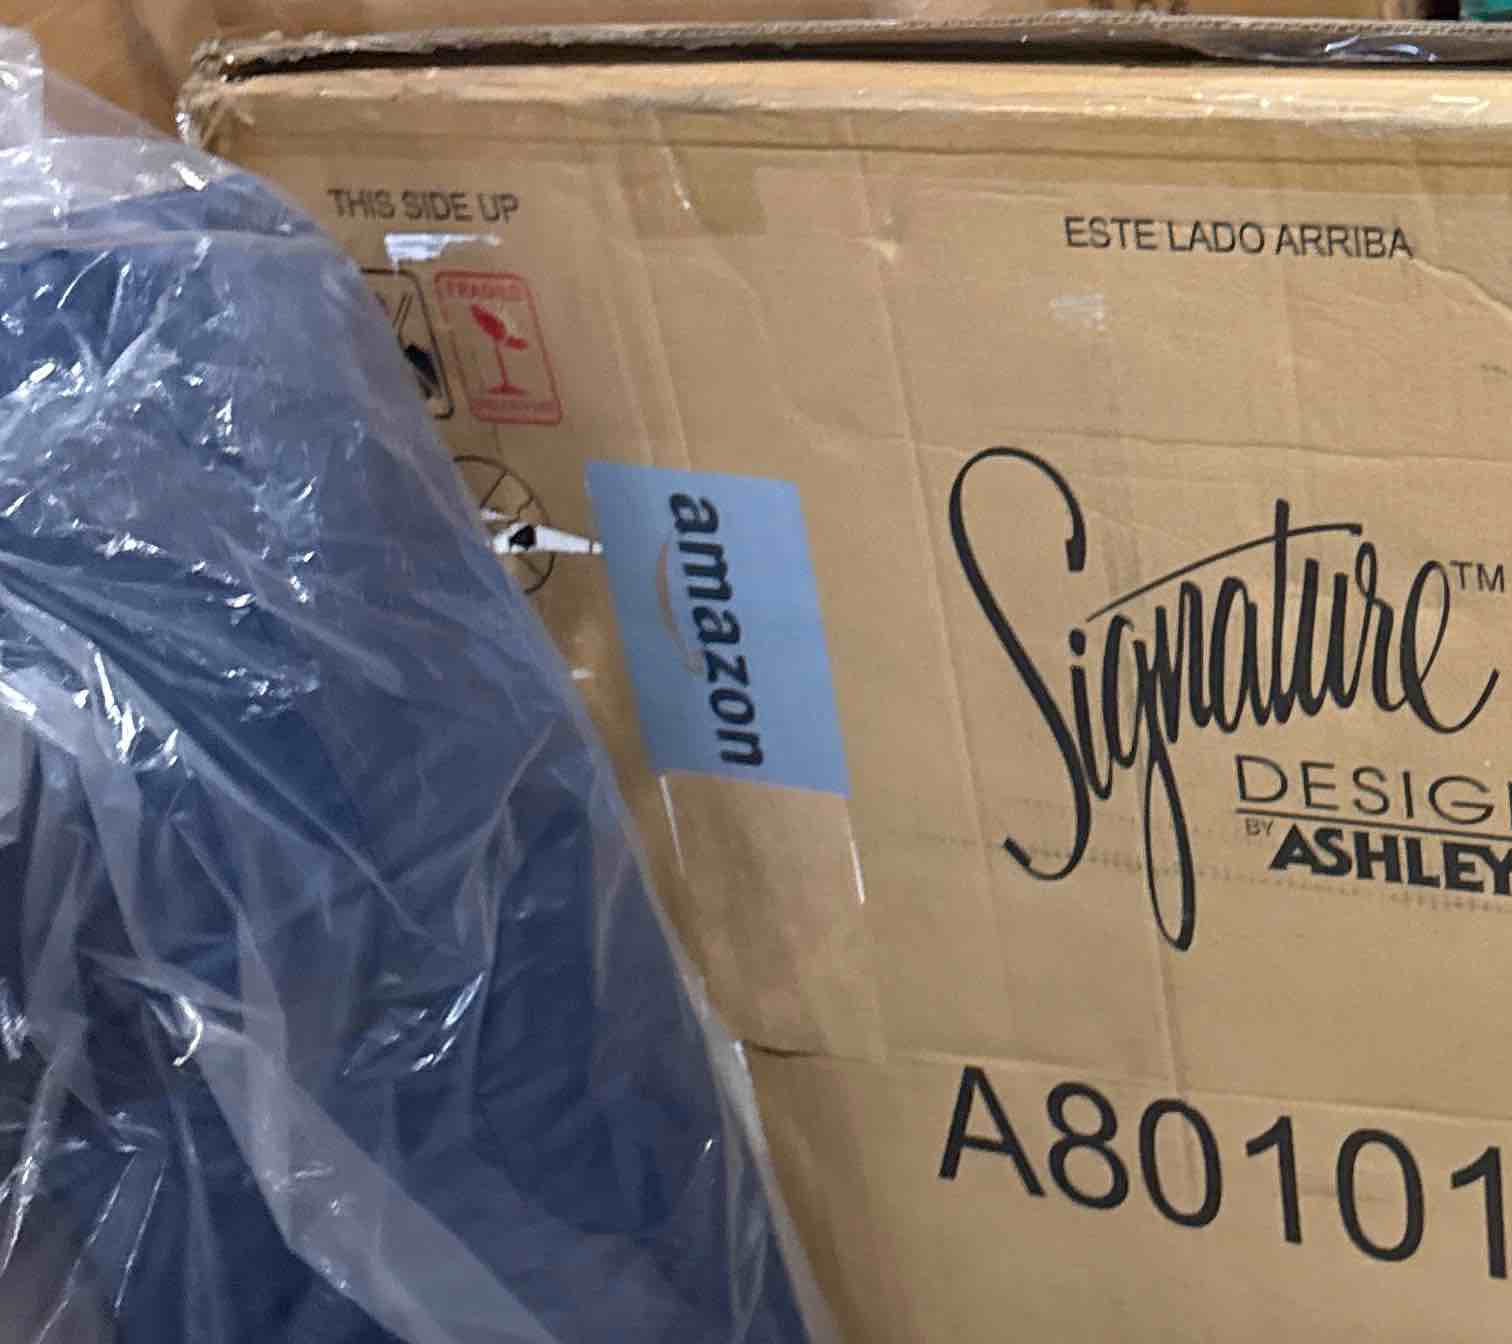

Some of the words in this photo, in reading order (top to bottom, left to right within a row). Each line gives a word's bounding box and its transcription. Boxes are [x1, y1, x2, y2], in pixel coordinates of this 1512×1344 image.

[328, 188, 395, 220] THIS
[401, 189, 473, 222] SIDE
[476, 192, 520, 224] UP
[1063, 214, 1158, 251] ESTE
[1167, 219, 1266, 255] LADO
[1275, 222, 1414, 259] ARRIBA
[668, 491, 764, 768] amazon
[949, 445, 1500, 953] Signature
[1245, 817, 1274, 837] BY
